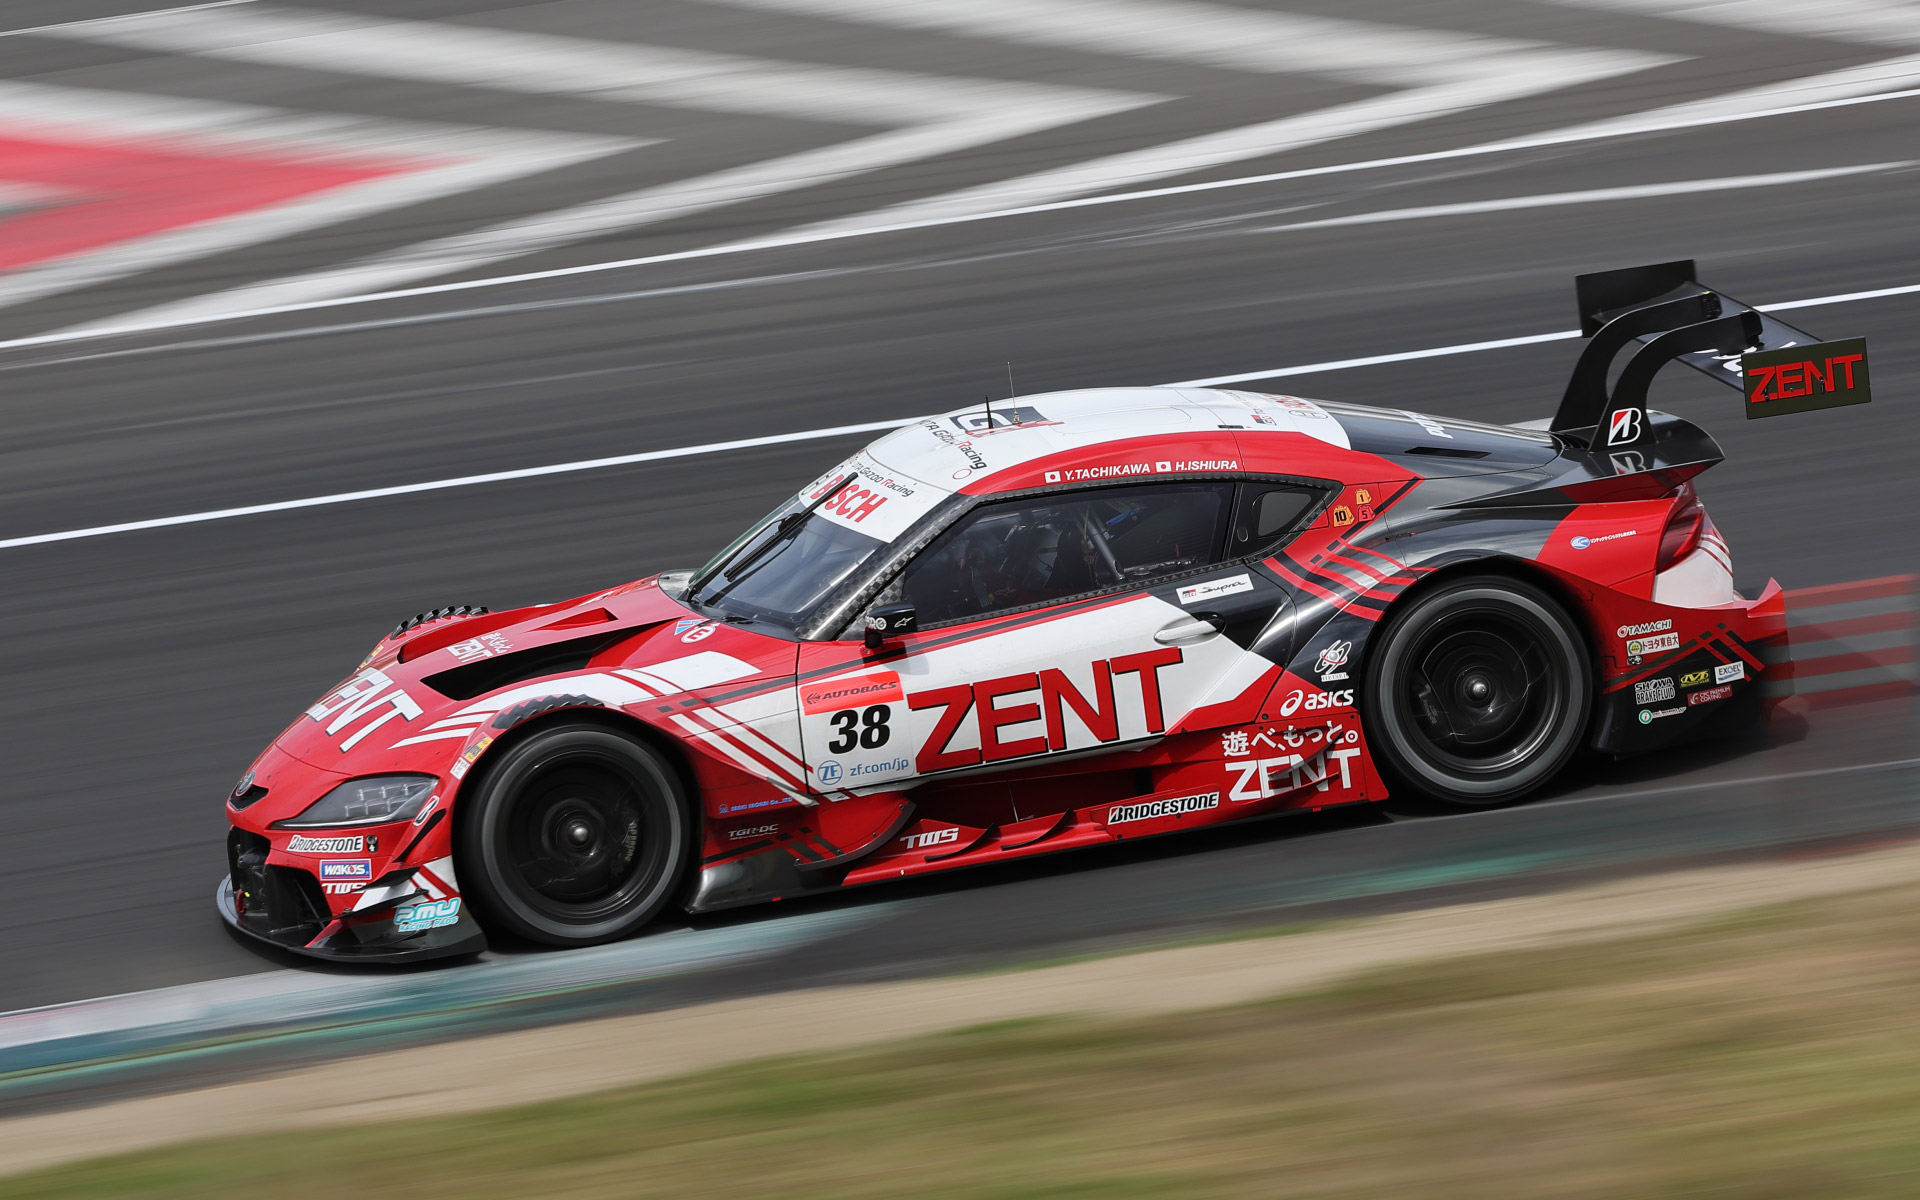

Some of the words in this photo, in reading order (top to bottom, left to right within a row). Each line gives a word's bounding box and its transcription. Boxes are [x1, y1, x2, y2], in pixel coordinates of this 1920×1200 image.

[1748, 353, 1863, 403] ZENT
[955, 441, 987, 470] Racing
[1064, 463, 1150, 481] Y.TACHIKAWA
[1175, 460, 1238, 471] H.ISHIURA
[880, 478, 915, 497] Racing
[1360, 494, 1364, 502] 1
[1335, 511, 1347, 522] 10
[1362, 510, 1368, 519] 5
[1199, 581, 1248, 593] Supra
[1628, 620, 1671, 635] TAMACHI
[446, 639, 494, 663] ZENT
[822, 682, 897, 700] AUTOBACS
[1635, 677, 1674, 691] SHOWA
[1710, 686, 1730, 695] PREMIUM
[1304, 689, 1354, 710] asics
[1636, 690, 1657, 704] BRAKE
[1657, 687, 1675, 701] FLUID
[1700, 694, 1721, 702] COATING
[906, 646, 1184, 774] ZENT
[828, 704, 891, 754] 38
[1221, 720, 1359, 757] 遊べ、もっと。
[819, 763, 842, 782] ZF
[850, 758, 909, 777] zf.com/jp
[1225, 747, 1361, 802] ZENT
[1109, 793, 1219, 825] BRIDGESTONE
[289, 836, 362, 852] BRIDGESTONE
[900, 827, 960, 850] TWS
[321, 882, 367, 894] TWS
[433, 917, 458, 928] PADS
